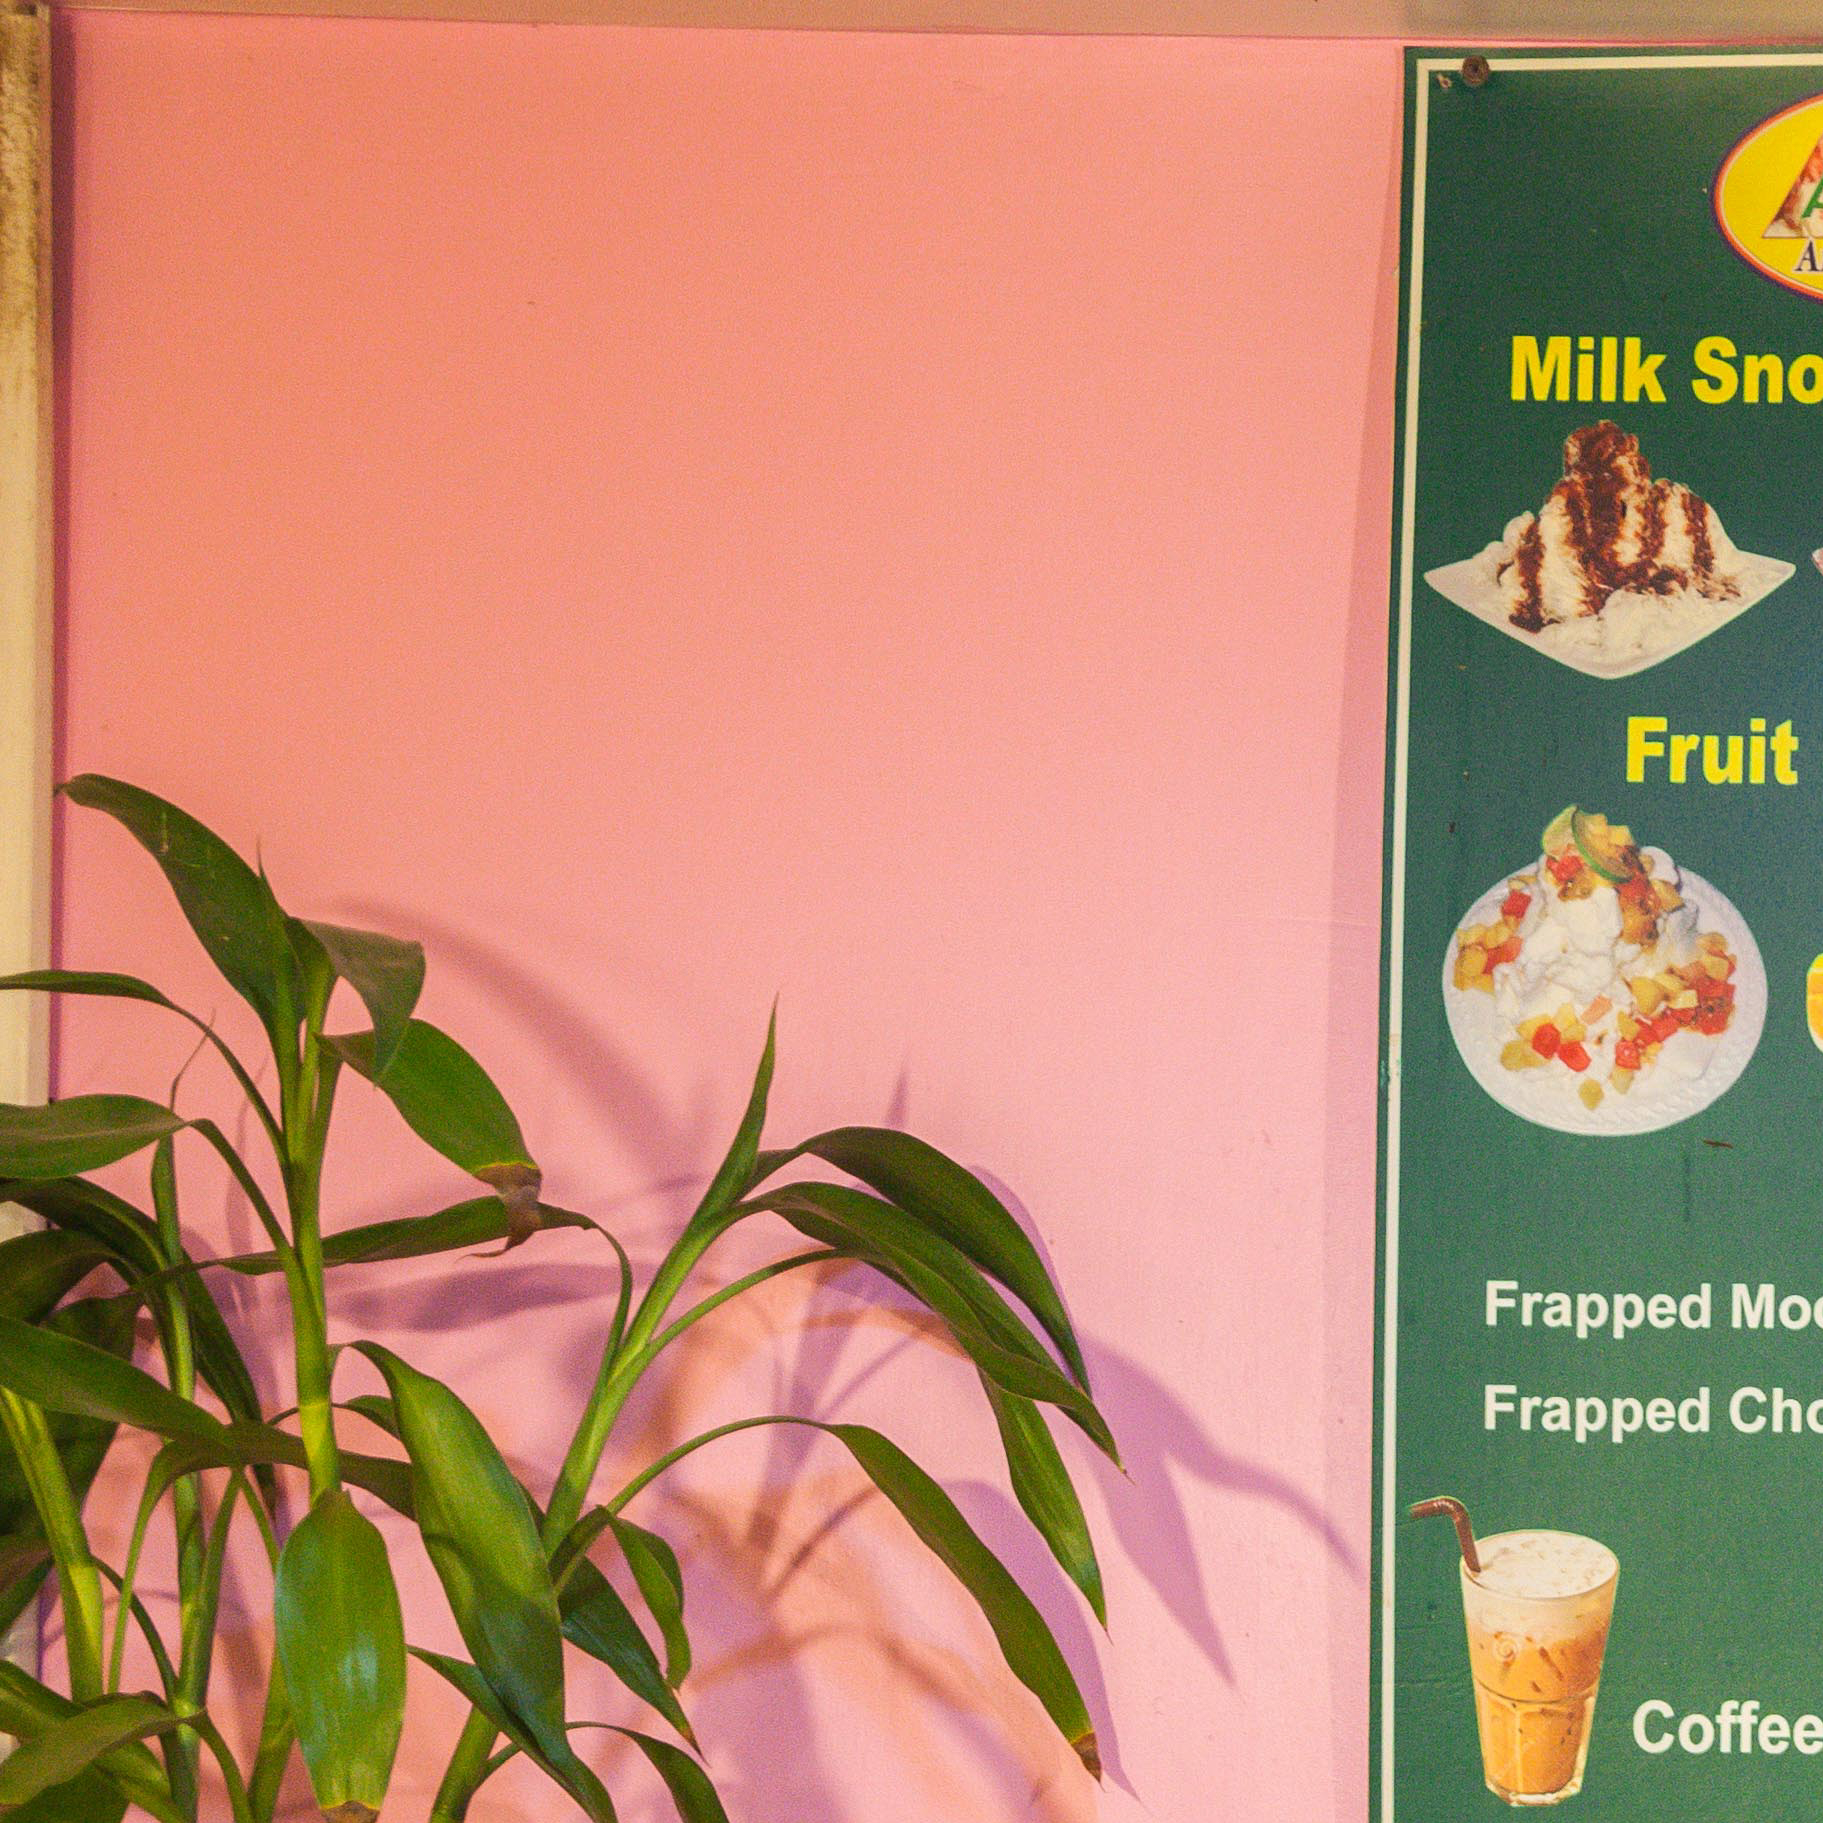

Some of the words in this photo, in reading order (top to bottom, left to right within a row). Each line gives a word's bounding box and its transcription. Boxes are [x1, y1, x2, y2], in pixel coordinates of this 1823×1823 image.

[1512, 336, 1665, 402] Milk
[1627, 717, 1798, 785] Fruit
[1486, 1280, 1712, 1340] Frapped
[1484, 1384, 1710, 1444] Frapped
